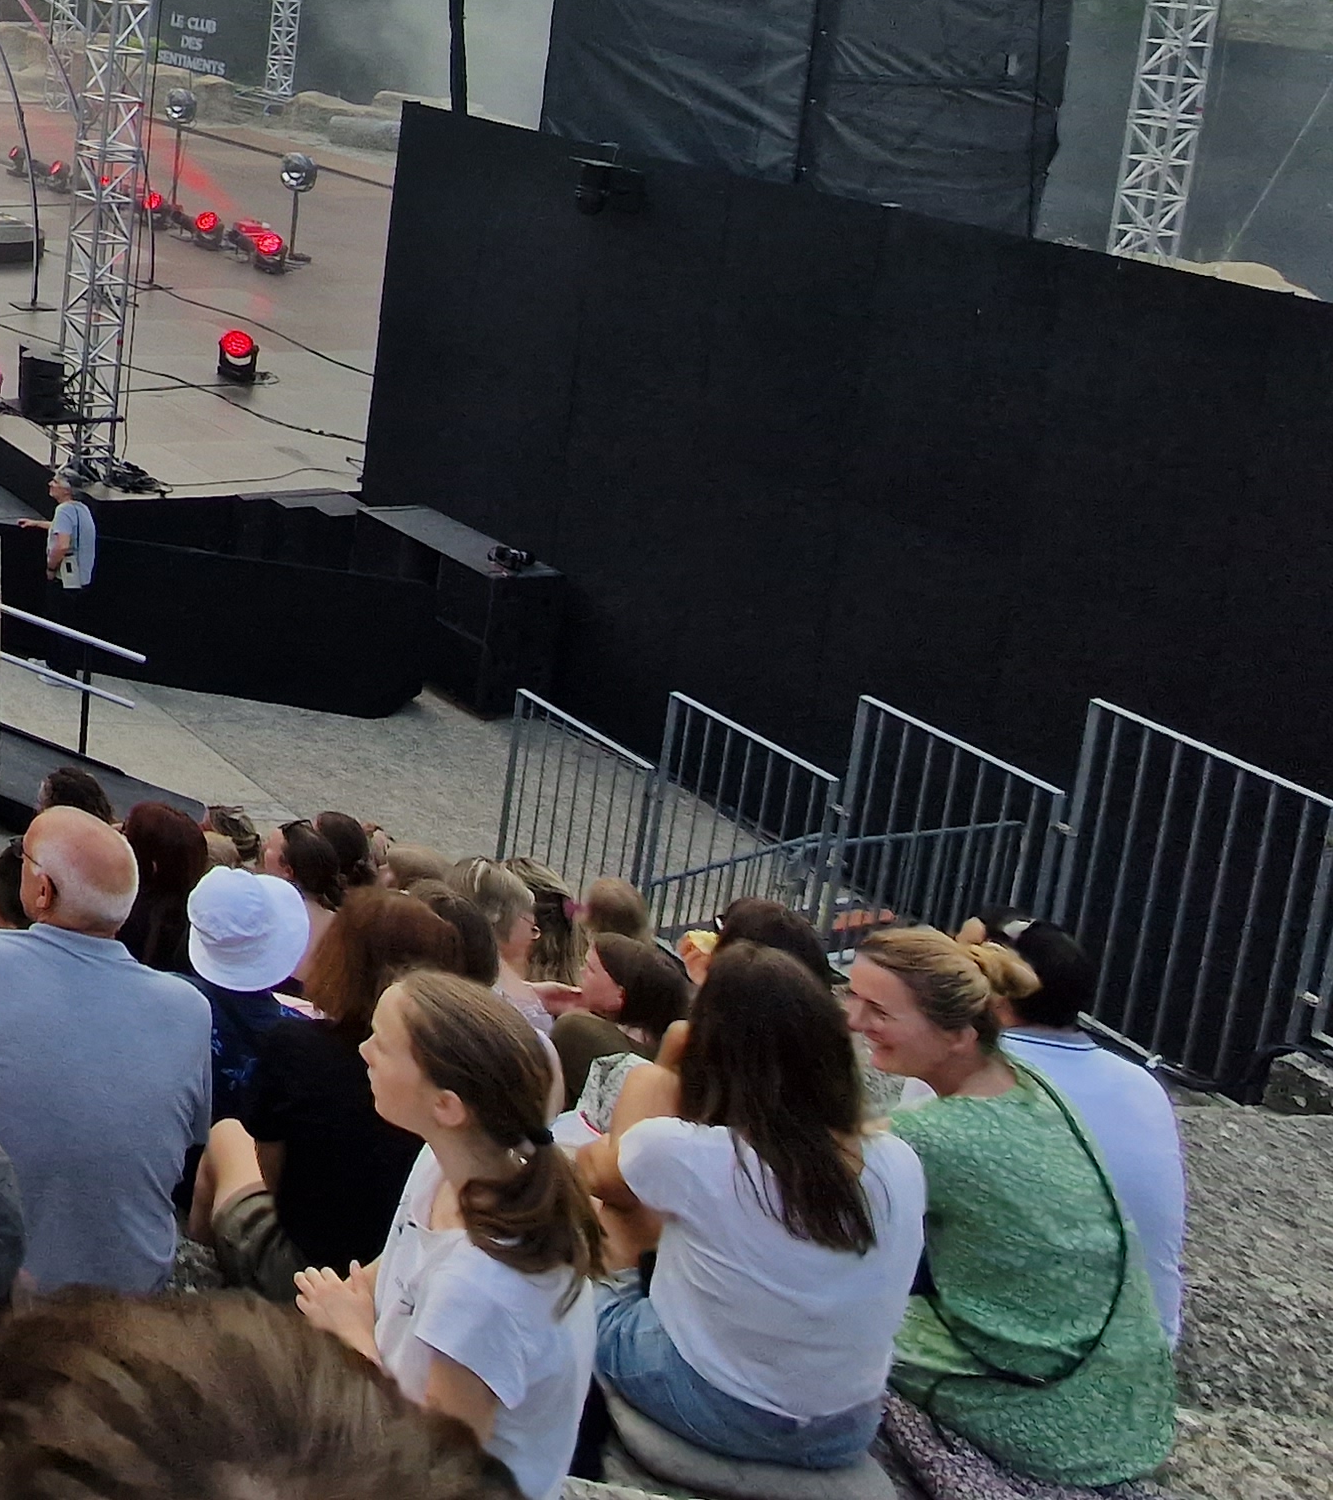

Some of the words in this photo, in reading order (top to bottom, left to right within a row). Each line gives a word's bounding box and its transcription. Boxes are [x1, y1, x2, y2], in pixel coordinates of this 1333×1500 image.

[170, 10, 184, 29] LE
[187, 16, 217, 34] CLUB
[180, 34, 204, 51] DES
[157, 49, 226, 76] SENTIMENTS
